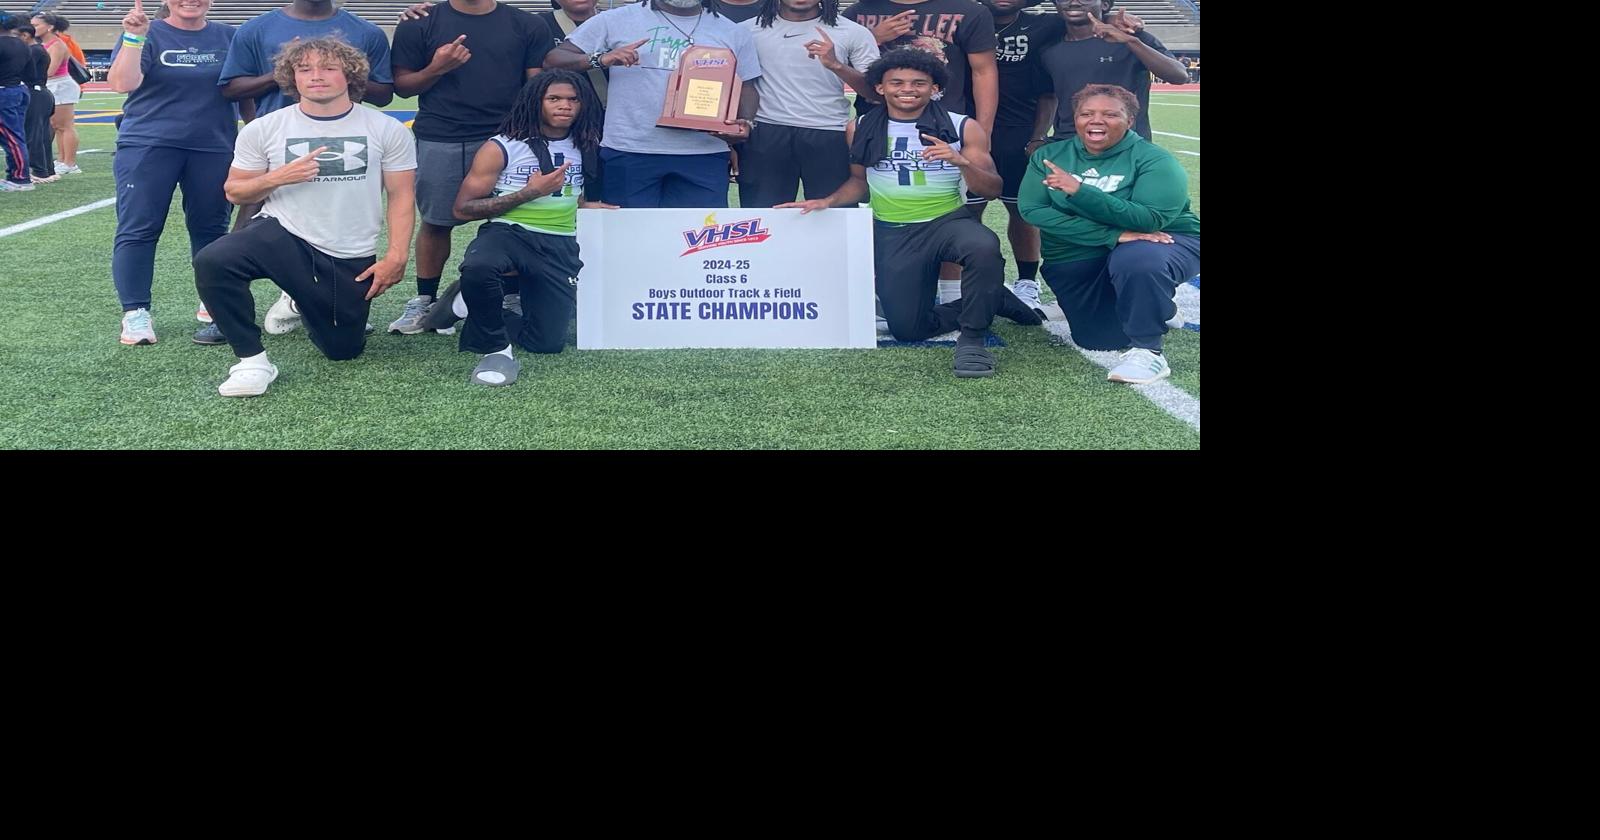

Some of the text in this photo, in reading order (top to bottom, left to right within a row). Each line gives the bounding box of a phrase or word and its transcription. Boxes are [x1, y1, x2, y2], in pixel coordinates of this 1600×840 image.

[322, 175, 366, 183] ARMOUR
[683, 218, 768, 248] VHSL
[702, 259, 750, 270] 2024-25
[705, 273, 748, 284] Class 6
[649, 288, 801, 300] Boys Outdoor Track & Field
[632, 302, 819, 321] STATE CHAMPIONS
